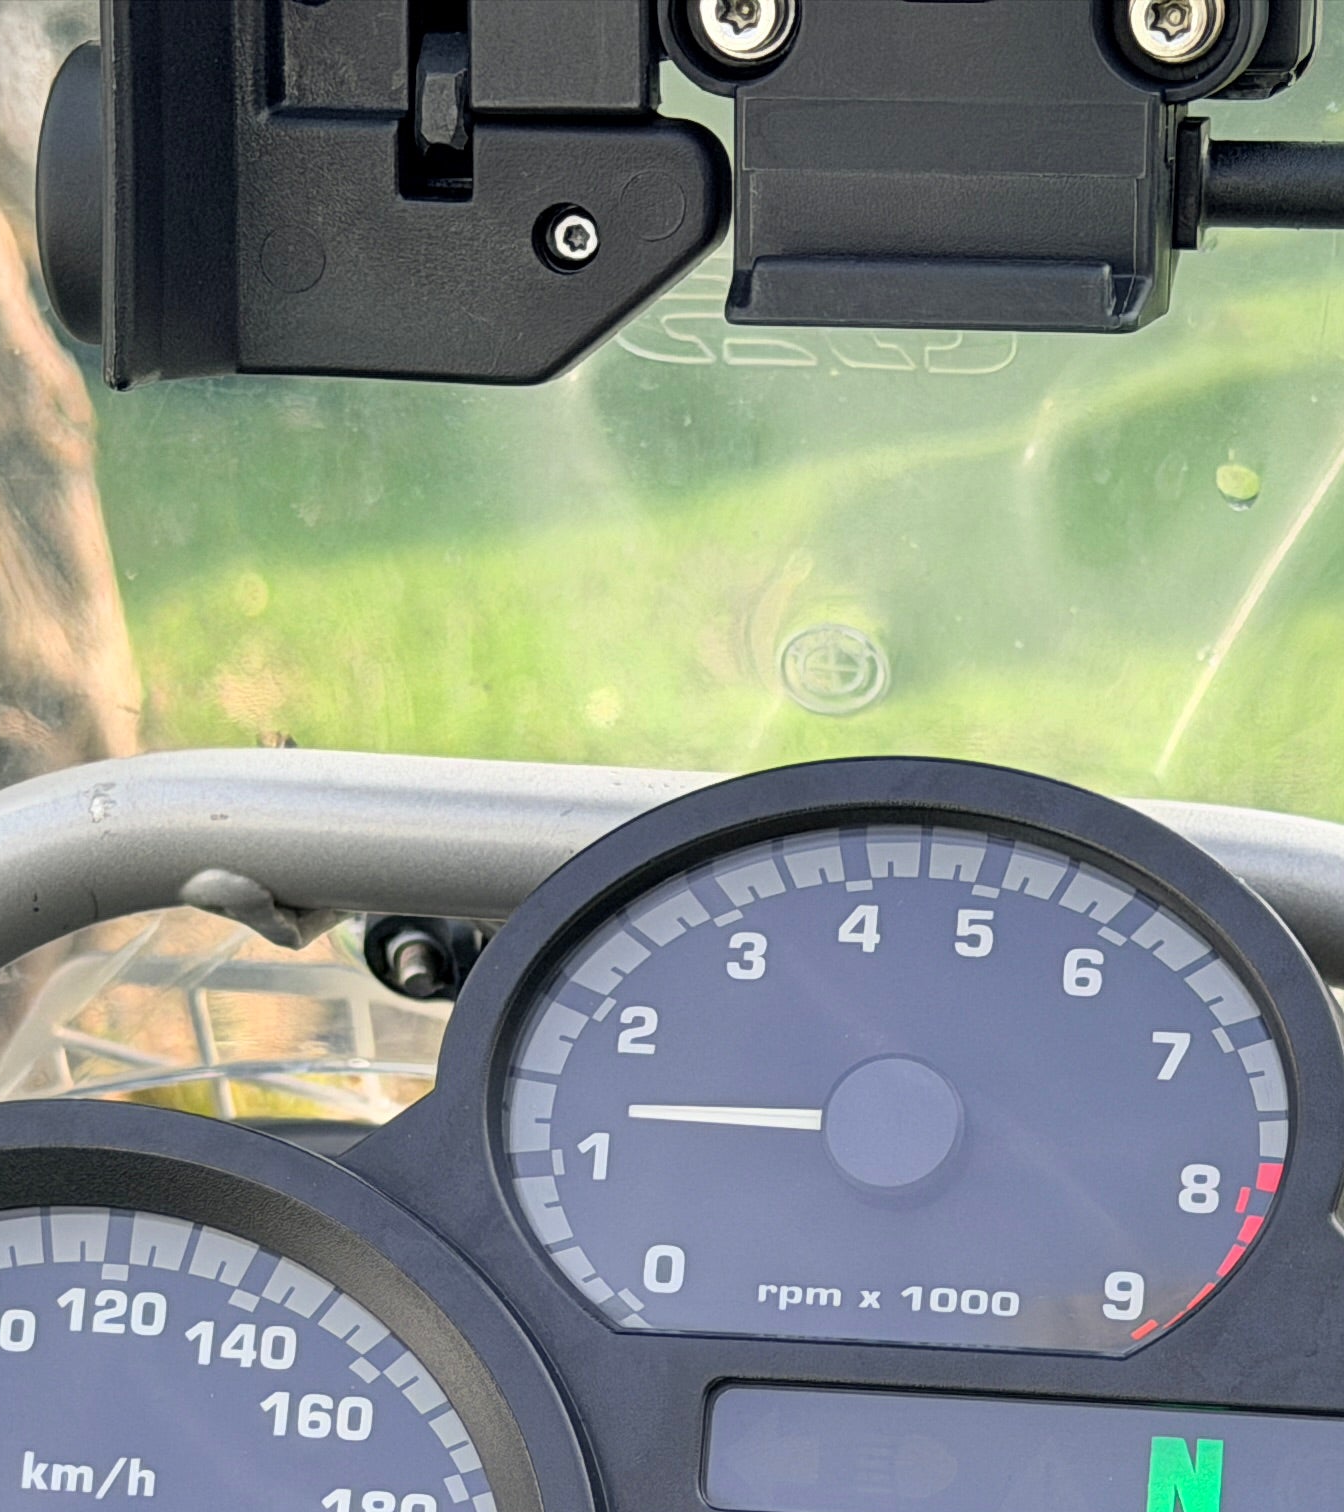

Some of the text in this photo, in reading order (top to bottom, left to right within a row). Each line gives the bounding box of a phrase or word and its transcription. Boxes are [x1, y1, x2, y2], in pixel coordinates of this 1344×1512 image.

[838, 904, 881, 953] 4
[954, 909, 994, 958] 5
[726, 931, 768, 980] 3
[1062, 948, 1105, 997] 6
[617, 1005, 658, 1055] 2
[1152, 1031, 1191, 1081] 7
[577, 1132, 610, 1181] 1
[1178, 1163, 1221, 1214] 8
[643, 1244, 686, 1294] 0
[56, 1287, 167, 1336] 120
[757, 1284, 1020, 1317] rpm x 1000
[1102, 1271, 1145, 1321] 9
[184, 1320, 297, 1370] 140
[259, 1391, 374, 1441] 160
[21, 1450, 156, 1500] km/h
